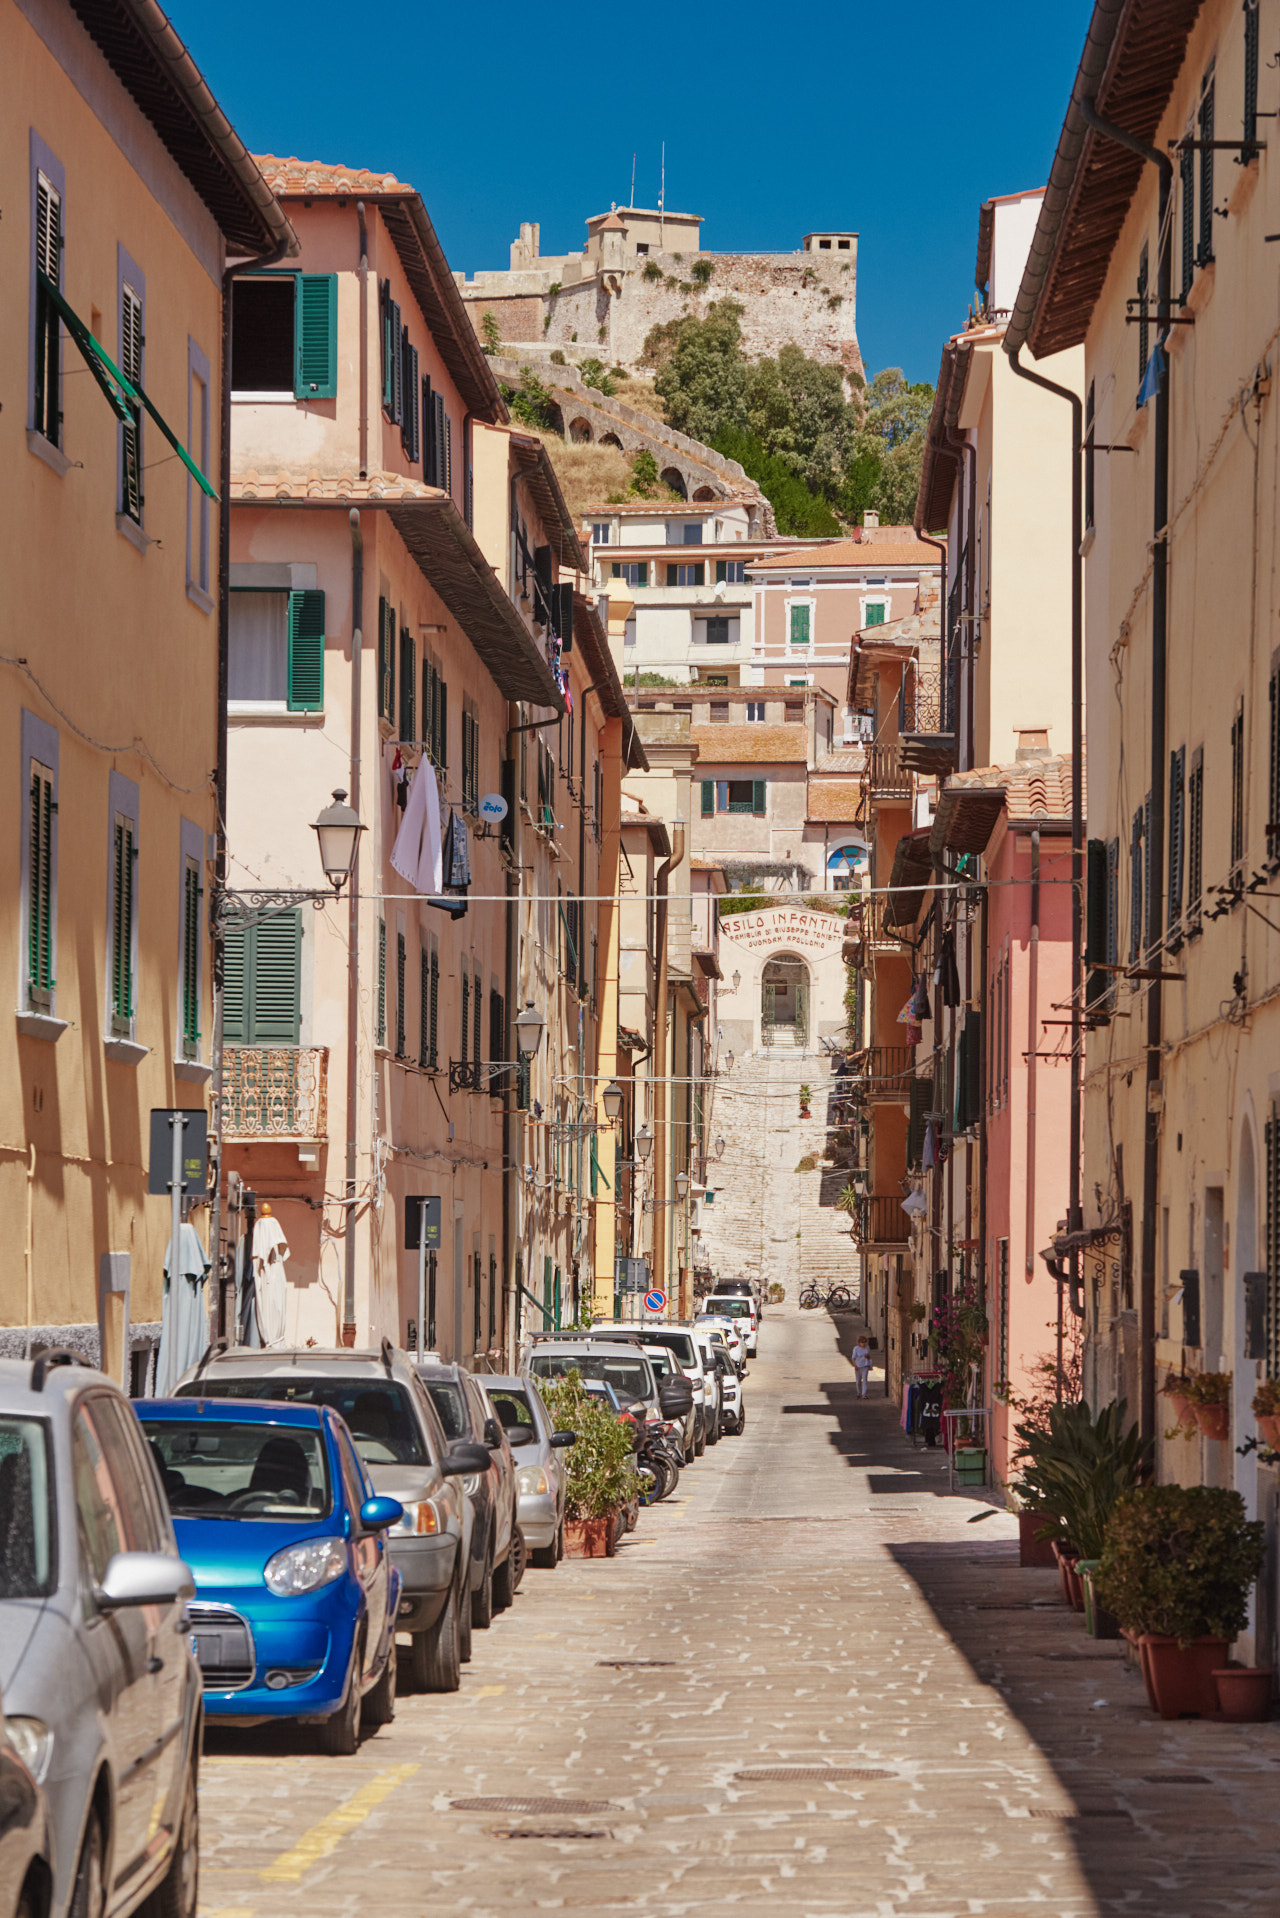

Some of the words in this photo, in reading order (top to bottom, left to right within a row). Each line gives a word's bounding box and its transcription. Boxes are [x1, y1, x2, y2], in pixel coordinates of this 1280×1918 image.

[723, 916, 764, 932] ASILO
[772, 913, 840, 933] INFANTIL
[774, 926, 809, 936] GIUSEPPE
[787, 935, 825, 949] APOLLONIO
